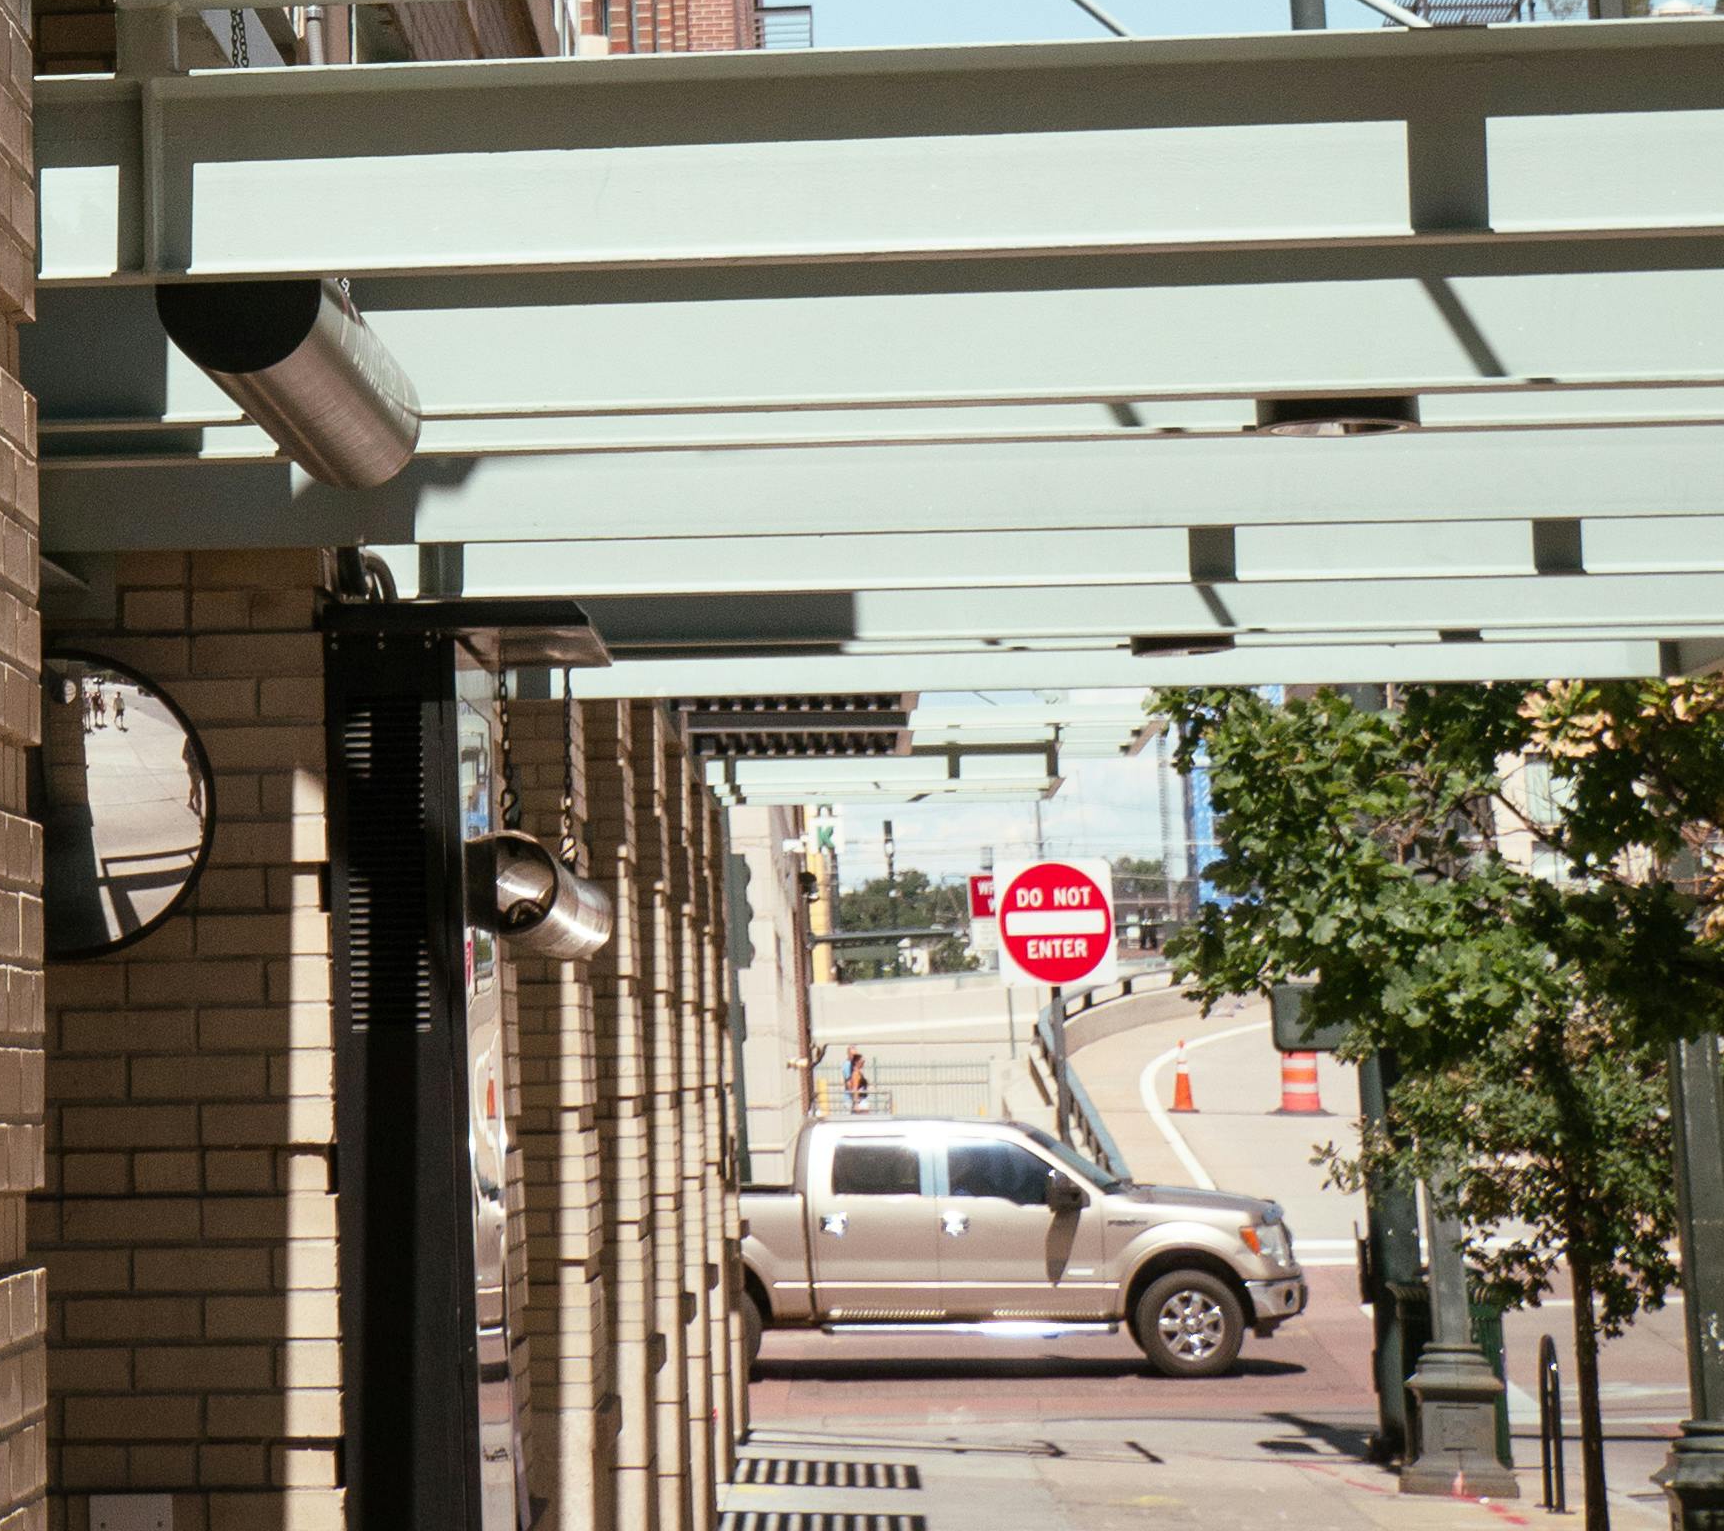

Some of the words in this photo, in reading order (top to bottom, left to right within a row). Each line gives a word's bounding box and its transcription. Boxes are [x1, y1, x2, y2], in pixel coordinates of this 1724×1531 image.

[1016, 887, 1044, 908] DO
[1053, 885, 1092, 907] NOT
[1027, 938, 1088, 960] ENTER
